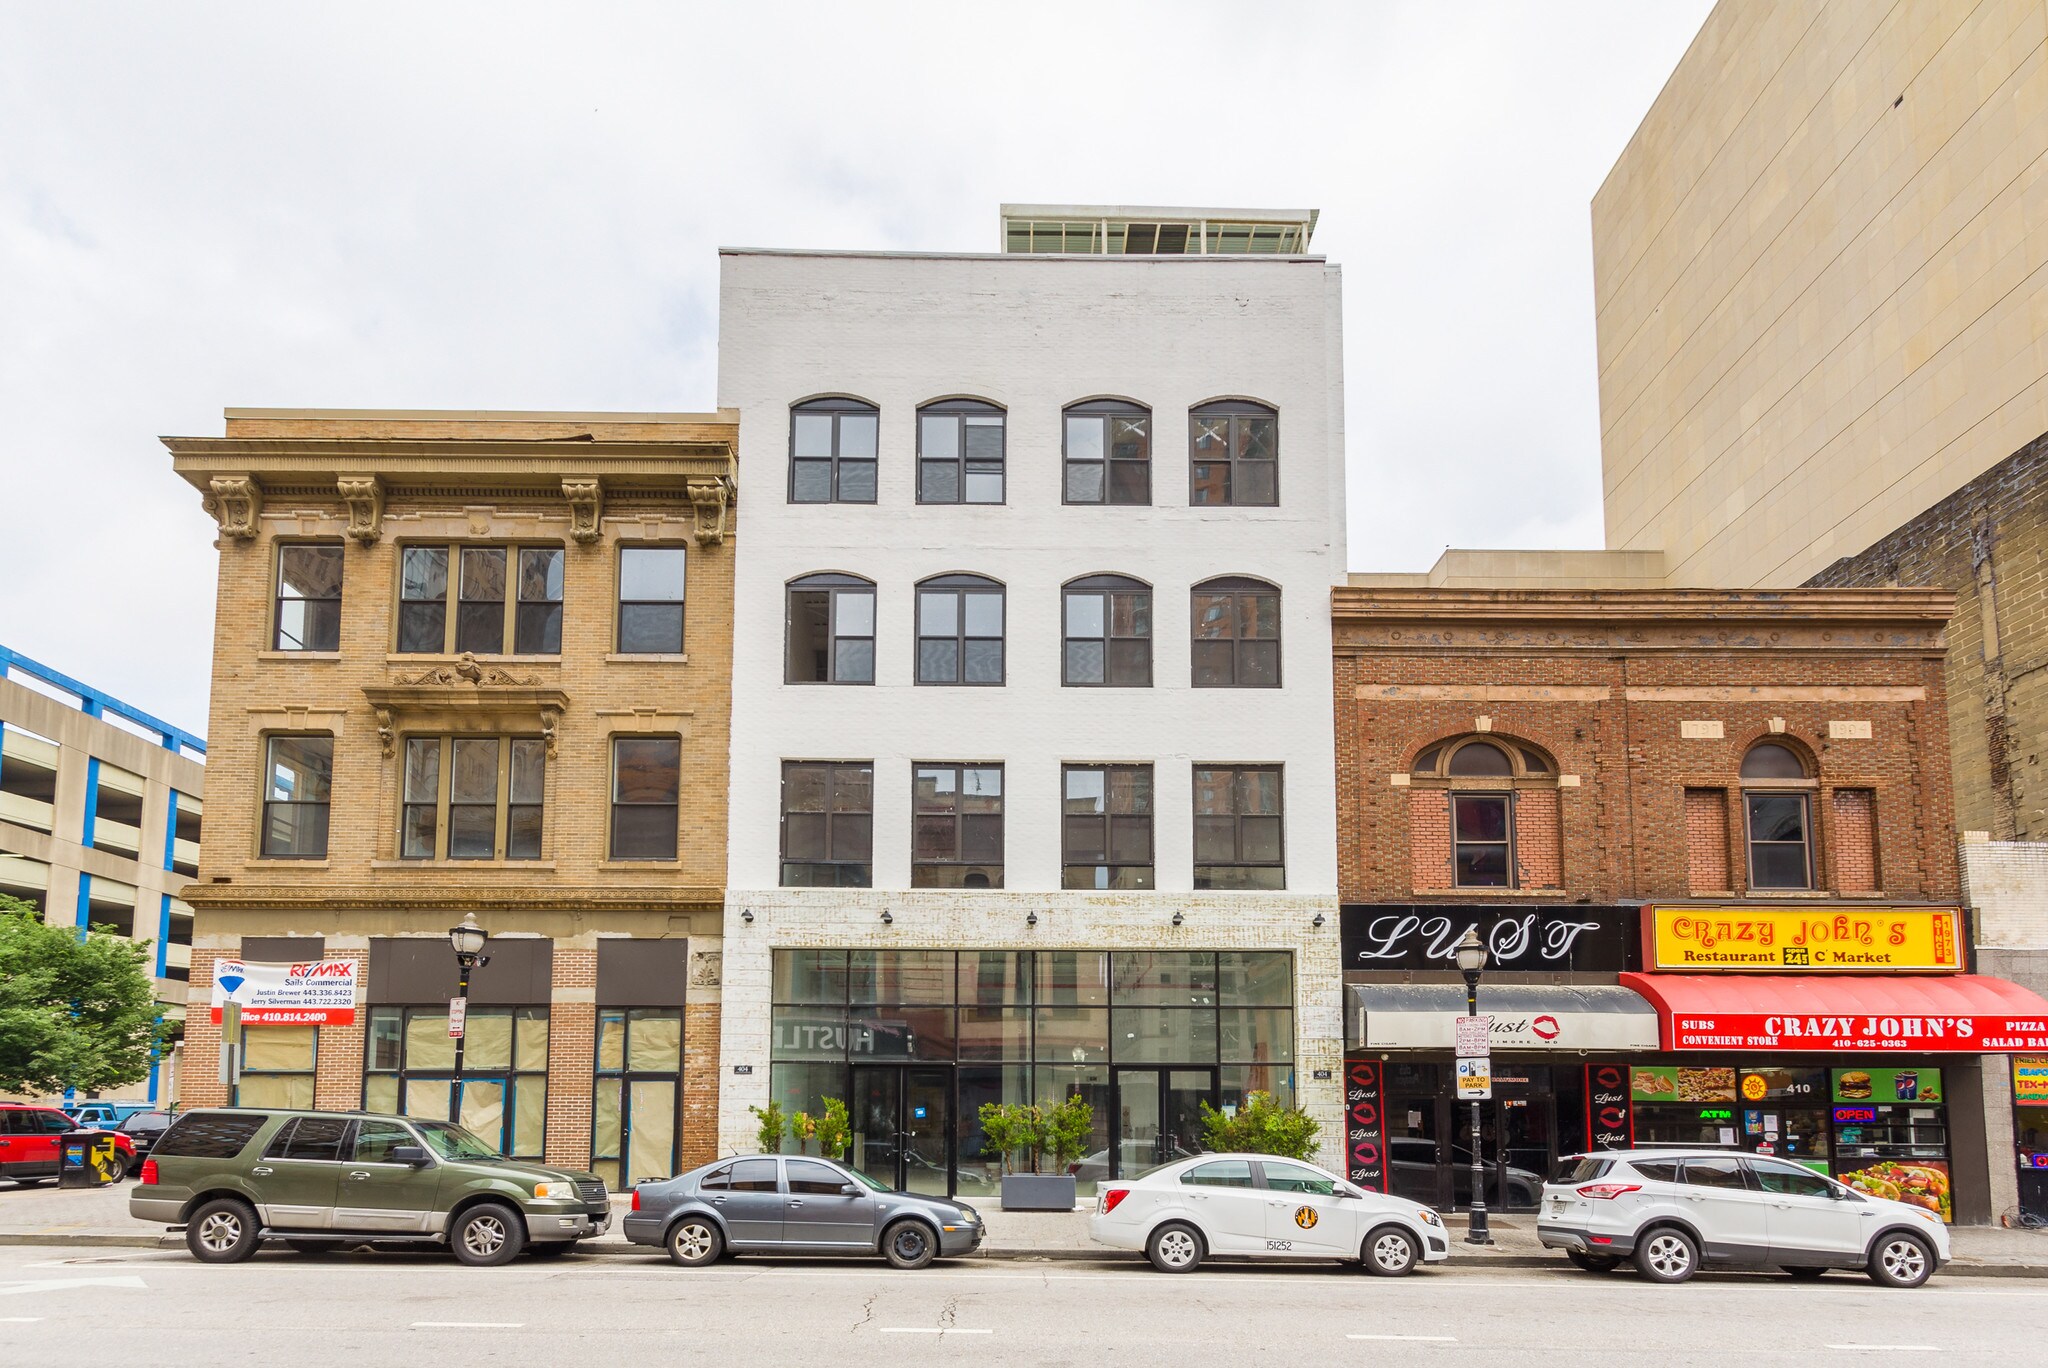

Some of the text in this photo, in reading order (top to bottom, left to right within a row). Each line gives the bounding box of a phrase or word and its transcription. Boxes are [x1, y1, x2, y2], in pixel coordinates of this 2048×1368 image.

[1359, 913, 1600, 965] LUST
[1934, 919, 1943, 958] SINCE
[1943, 921, 1952, 957] 1973
[1684, 950, 1776, 962] Restaurant
[1833, 952, 1892, 963] Market
[289, 962, 353, 978] RE/MAX
[284, 978, 353, 987] Sails Commercial
[256, 989, 276, 997] Justin
[302, 989, 352, 997] 443.336.8423
[250, 998, 267, 1006] Jerry
[302, 998, 352, 1006] 443.722.2320
[241, 1012, 327, 1022] ffice 410.814.2400
[1682, 1020, 1715, 1030] SUBS
[1764, 1017, 1974, 1037] CRAZY JOHN'S
[2005, 1021, 2047, 1032] PIZZA
[1682, 1035, 1778, 1046] CONVENIENT STORE
[1832, 1039, 1908, 1048] 410-625-0363
[1982, 1038, 2024, 1048] SALAD
[1786, 1084, 1811, 1094] 410
[1348, 1089, 1377, 1101] Lust
[1594, 1093, 1624, 1104] Lust
[1699, 1110, 1732, 1119] ATM
[1835, 1109, 1874, 1120] OPEN
[1349, 1128, 1379, 1140] Lust
[1596, 1132, 1625, 1144] Lust
[1351, 1168, 1381, 1180] Lust
[1266, 1240, 1292, 1251] 151252
